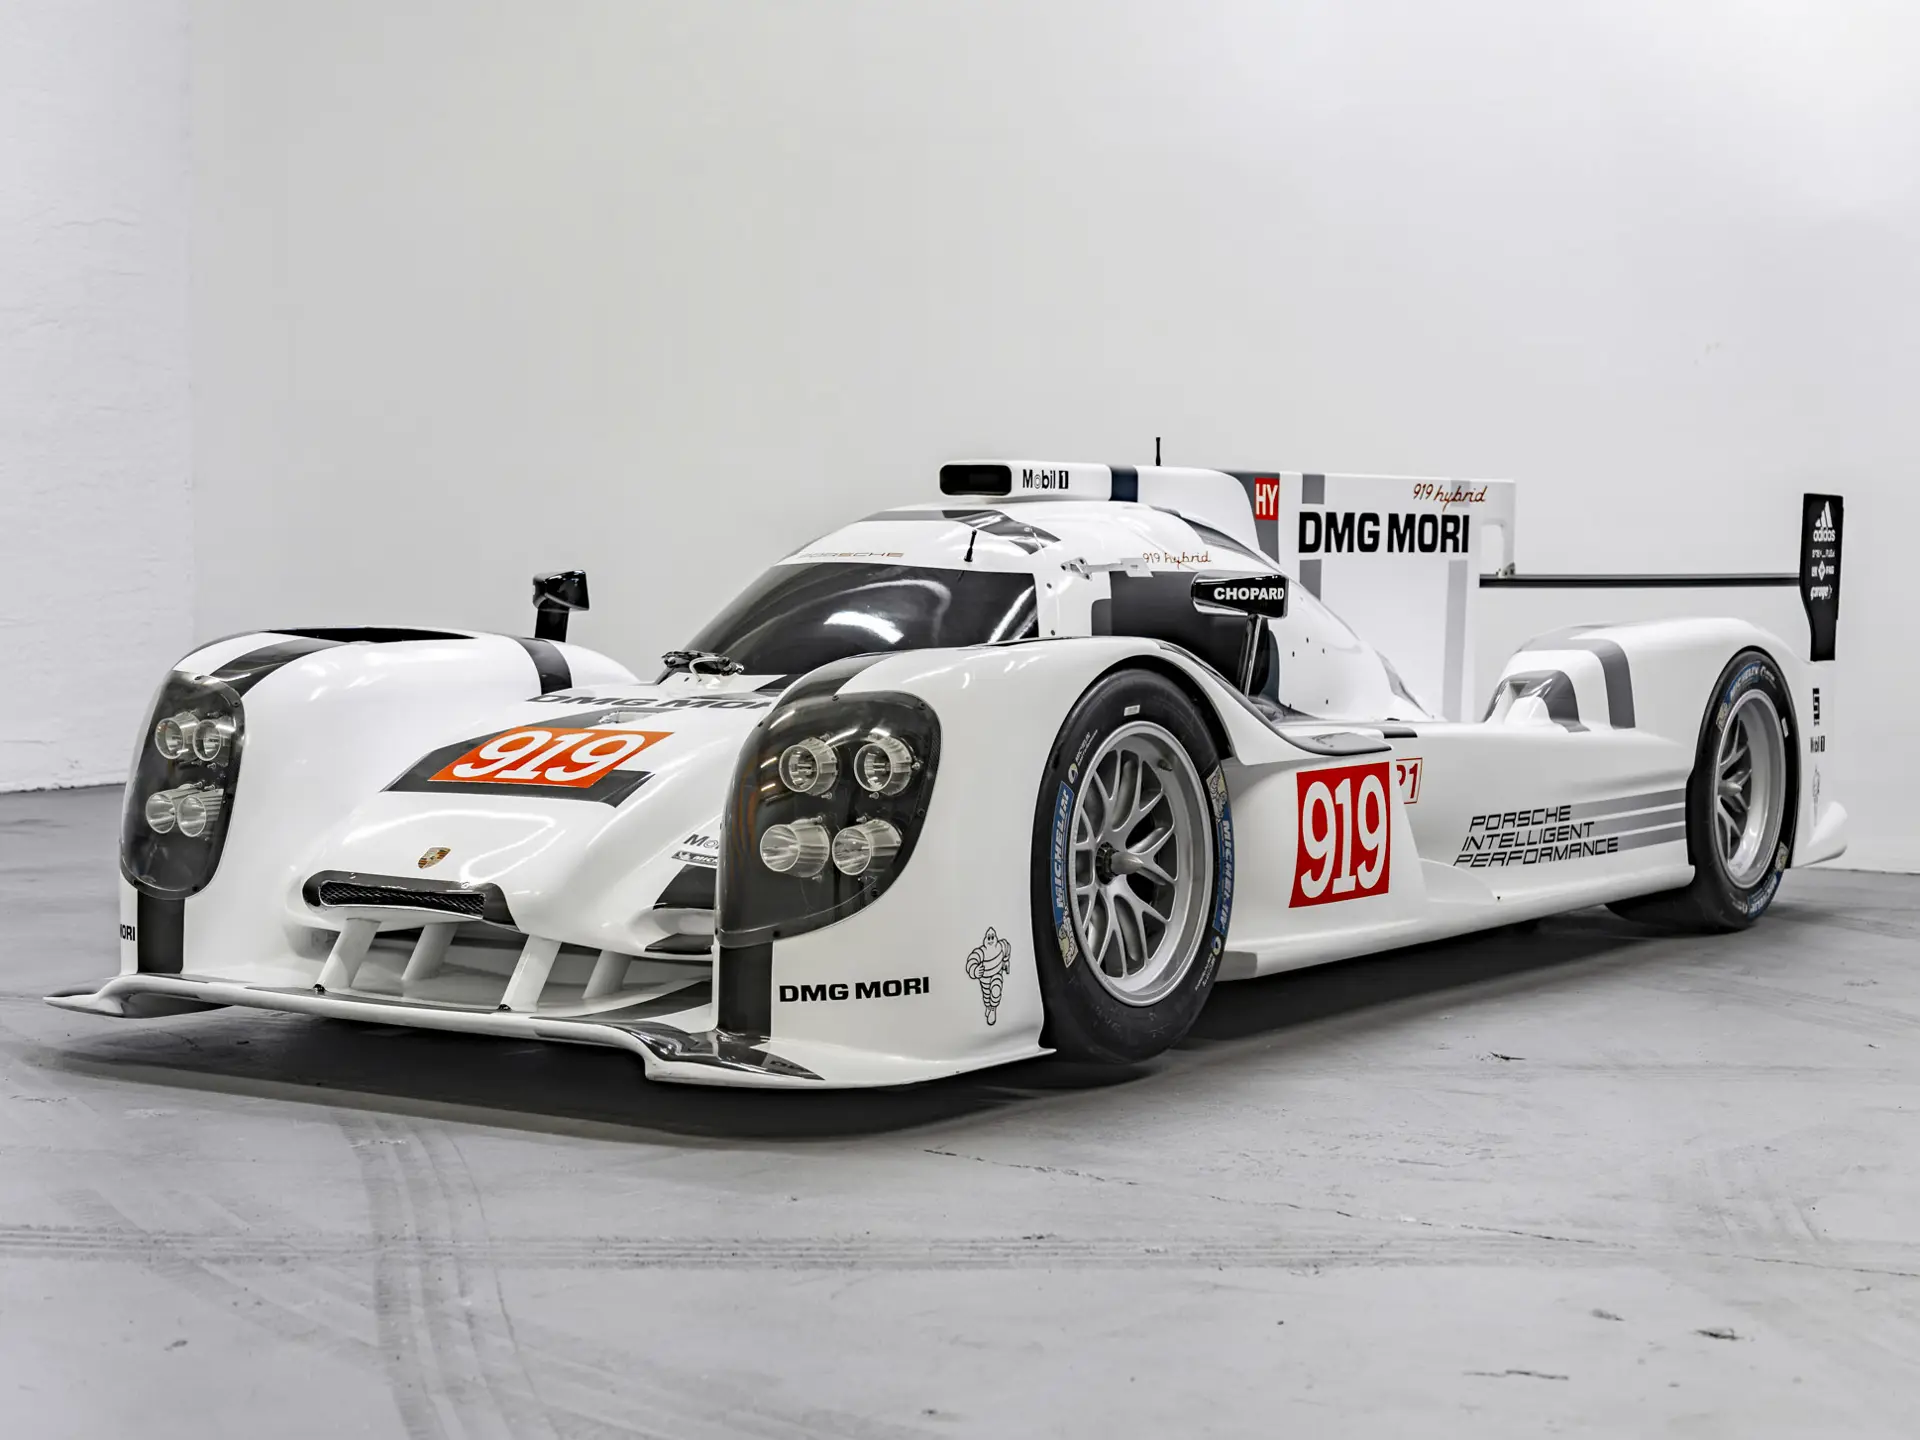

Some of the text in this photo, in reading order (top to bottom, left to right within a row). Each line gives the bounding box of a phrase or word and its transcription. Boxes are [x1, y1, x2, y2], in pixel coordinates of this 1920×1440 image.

[1022, 469, 1069, 490] Mobil 1
[1255, 483, 1279, 516] HY
[1413, 483, 1489, 512] 919 hybrid
[1298, 511, 1471, 554] DMG MORI
[1812, 526, 1836, 543] adidas
[1142, 550, 1213, 571] 919 hybrid
[1213, 587, 1286, 601] CHOPARD
[526, 694, 657, 706] DMG
[452, 730, 646, 783] 919
[1469, 804, 1572, 833] PORSCHE
[1055, 788, 1070, 909] MICHELIN
[1300, 774, 1388, 899] 919
[1461, 821, 1595, 852] INTELLIGENT
[1452, 836, 1619, 868] PERFORMANCE
[779, 976, 930, 1003] DMG MORI
